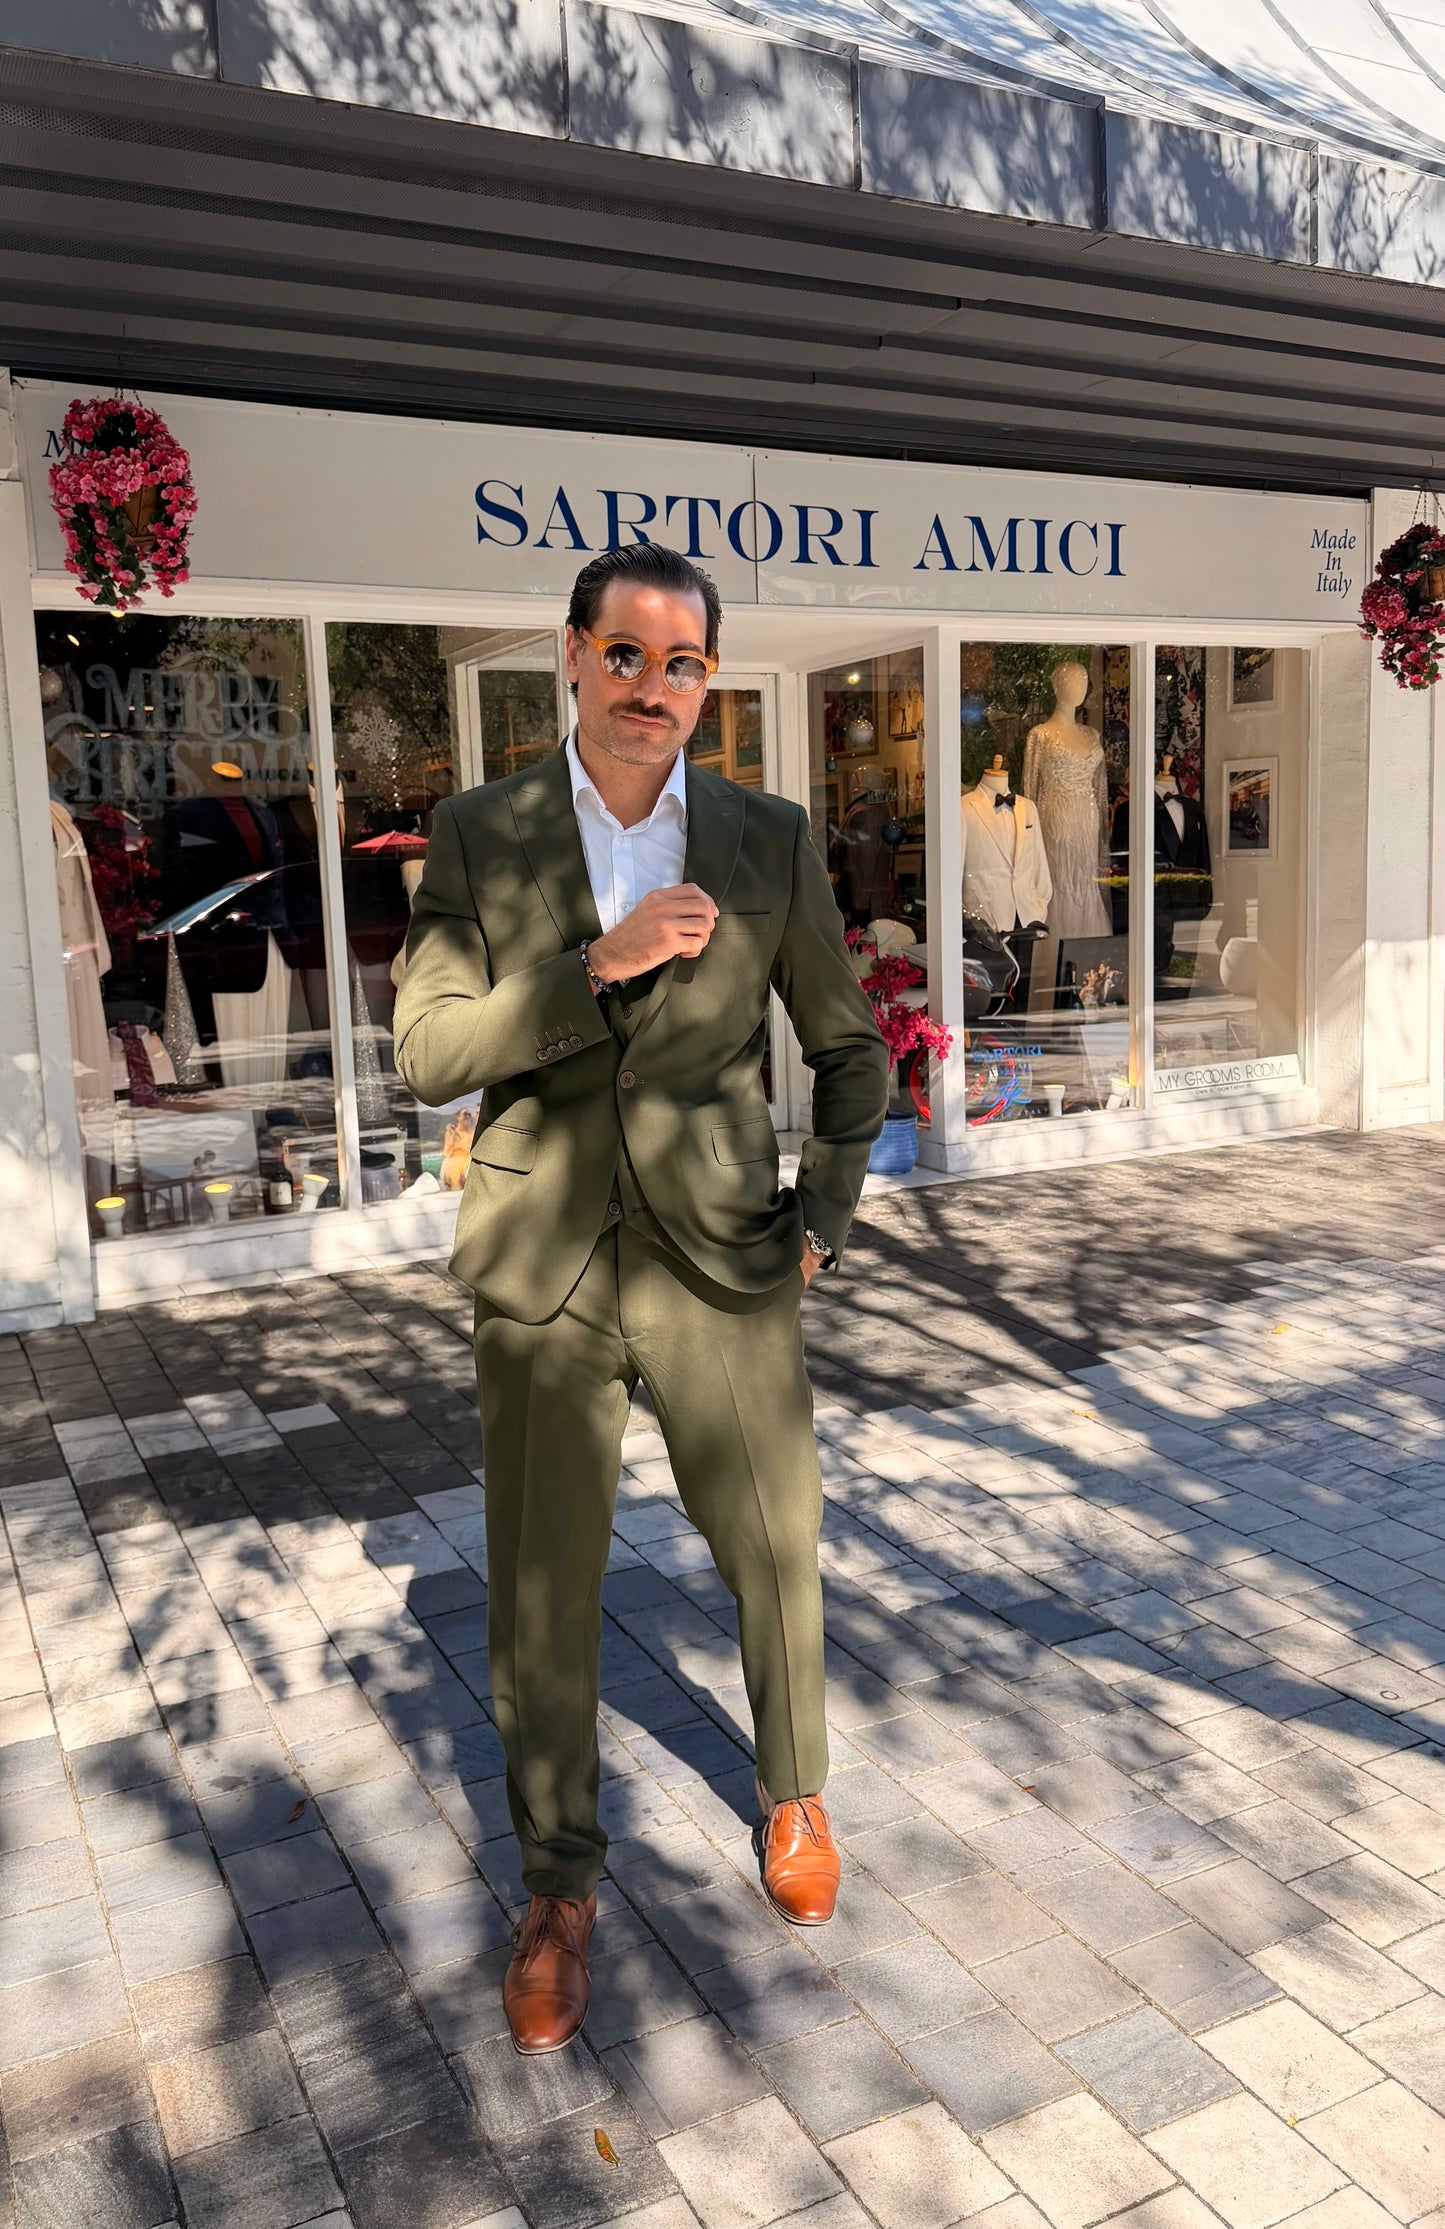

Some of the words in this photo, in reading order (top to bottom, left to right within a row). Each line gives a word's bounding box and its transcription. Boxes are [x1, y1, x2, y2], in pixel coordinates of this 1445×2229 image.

[474, 480, 880, 567] SARTORI
[913, 513, 1128, 576] AMICI
[1310, 528, 1356, 549] Made
[1324, 551, 1342, 570] In
[1315, 571, 1352, 599] Italy
[972, 1044, 1043, 1063] SARTORI
[1158, 1074, 1180, 1090] MY
[1184, 1066, 1241, 1087] GROOMS
[1246, 1061, 1285, 1080] ROOM
